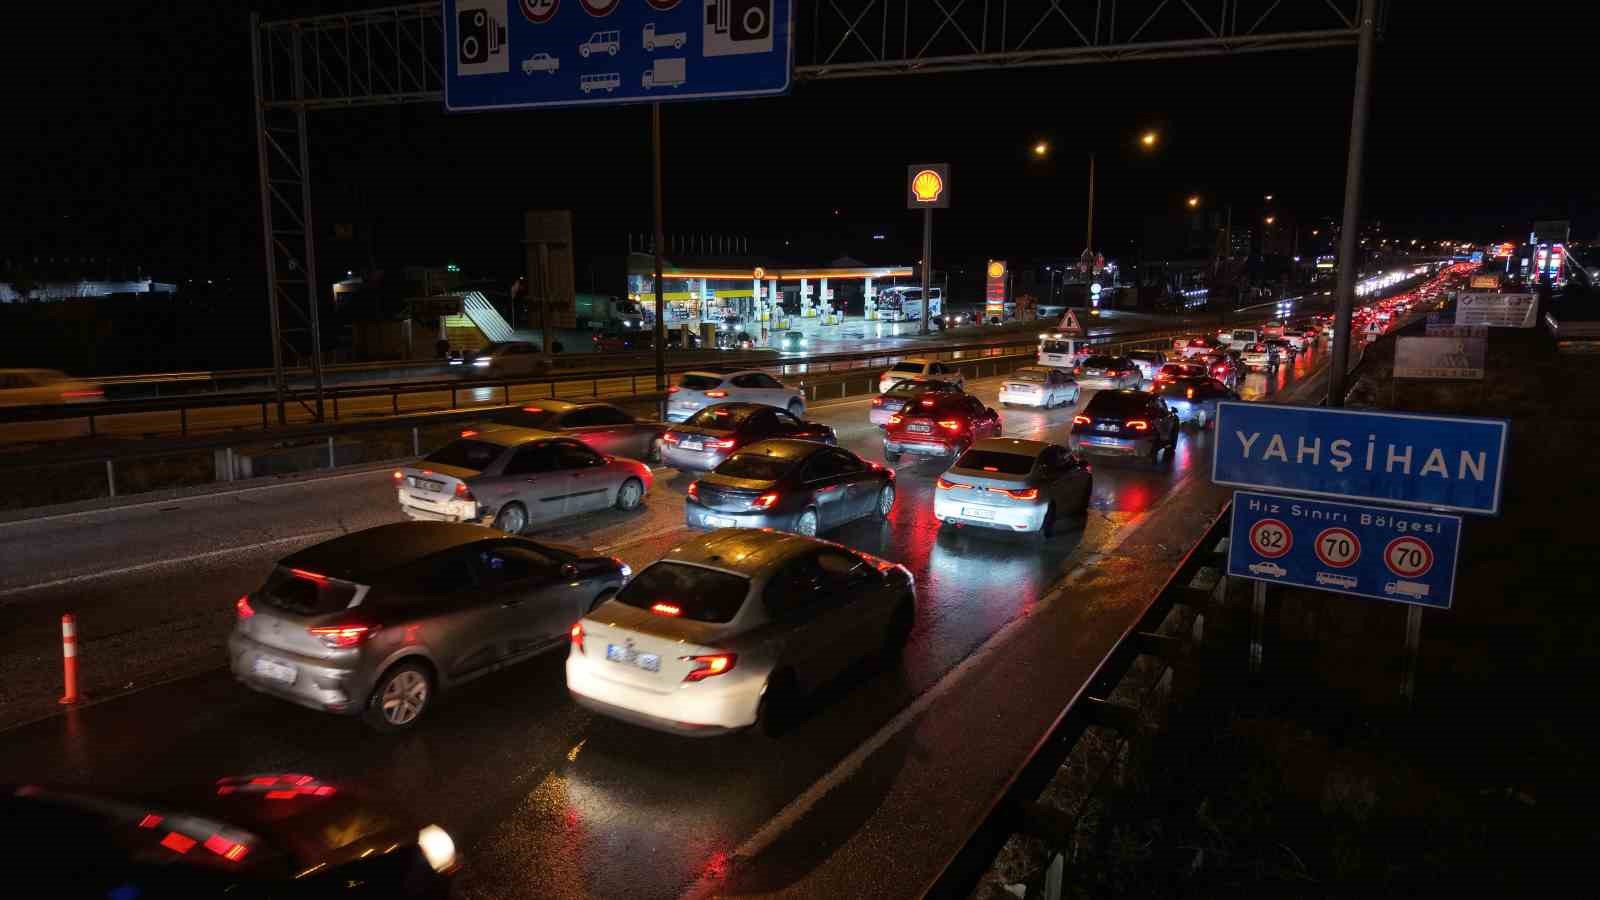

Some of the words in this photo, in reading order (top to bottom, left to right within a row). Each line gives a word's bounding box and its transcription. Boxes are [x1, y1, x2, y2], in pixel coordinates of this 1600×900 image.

[1236, 431, 1486, 480] YAHŞİHAN
[1250, 500, 1280, 513] Hız
[1292, 504, 1347, 522] Sınırı
[1260, 530, 1282, 548] 82
[1325, 539, 1349, 557] 70
[1397, 548, 1422, 567] 70
